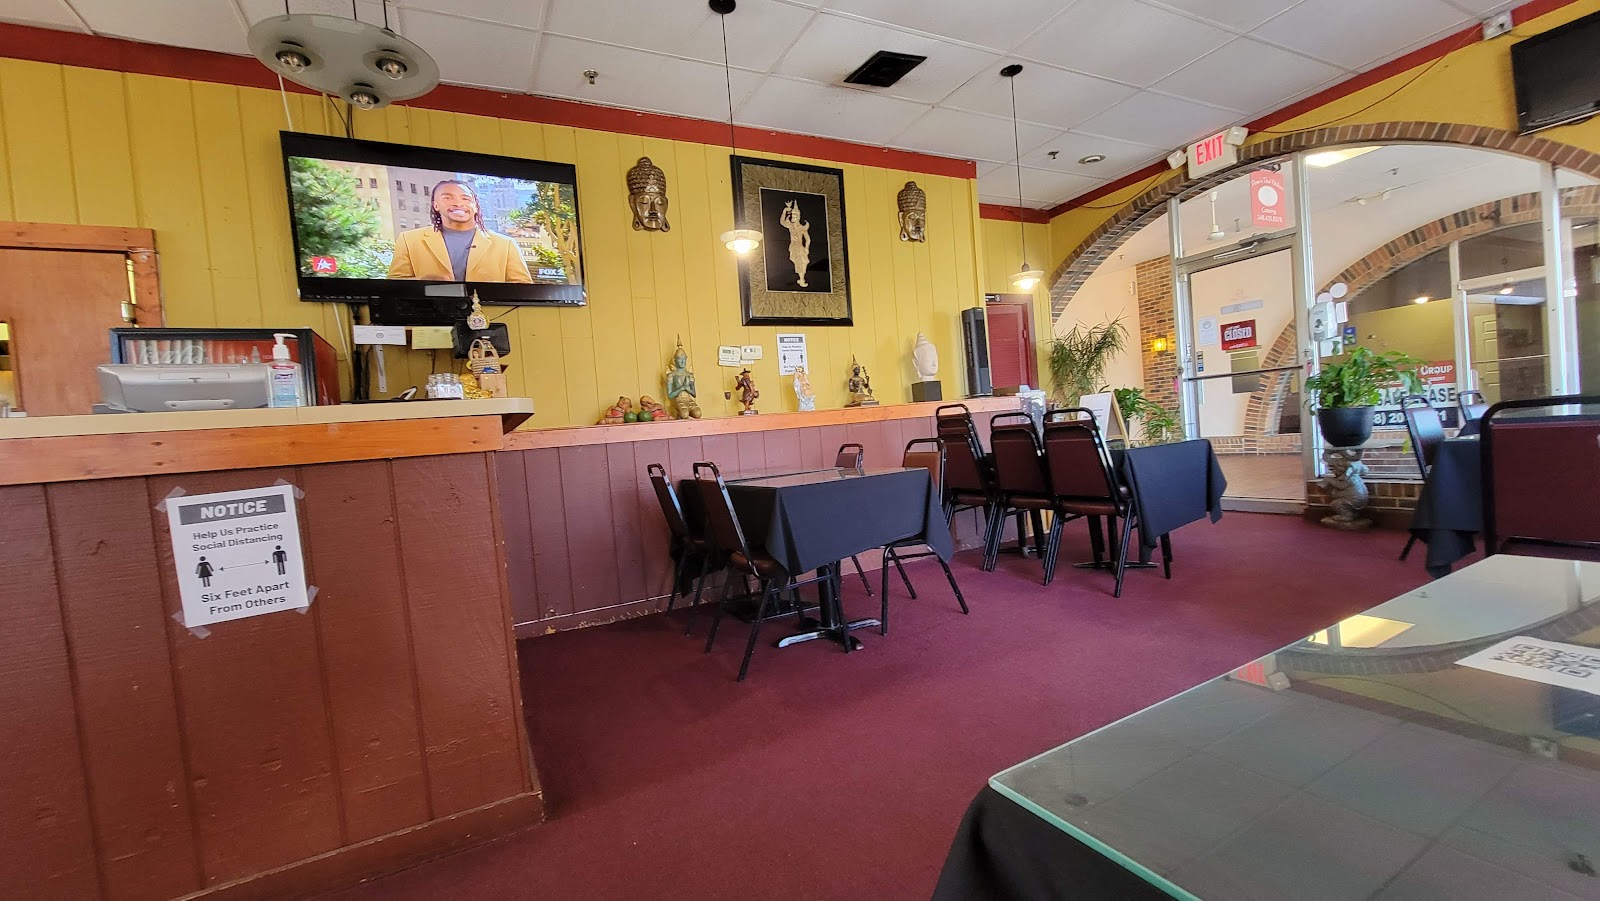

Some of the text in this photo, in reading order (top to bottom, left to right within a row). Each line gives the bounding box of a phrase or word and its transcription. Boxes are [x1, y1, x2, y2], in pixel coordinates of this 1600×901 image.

[1196, 135, 1224, 166] EXIT
[200, 499, 268, 520] NOTICE
[193, 523, 279, 541] Help Us Practice
[192, 533, 284, 552] Social Distancing
[201, 581, 290, 604] Six Feet Apart
[209, 595, 286, 615] From Others
